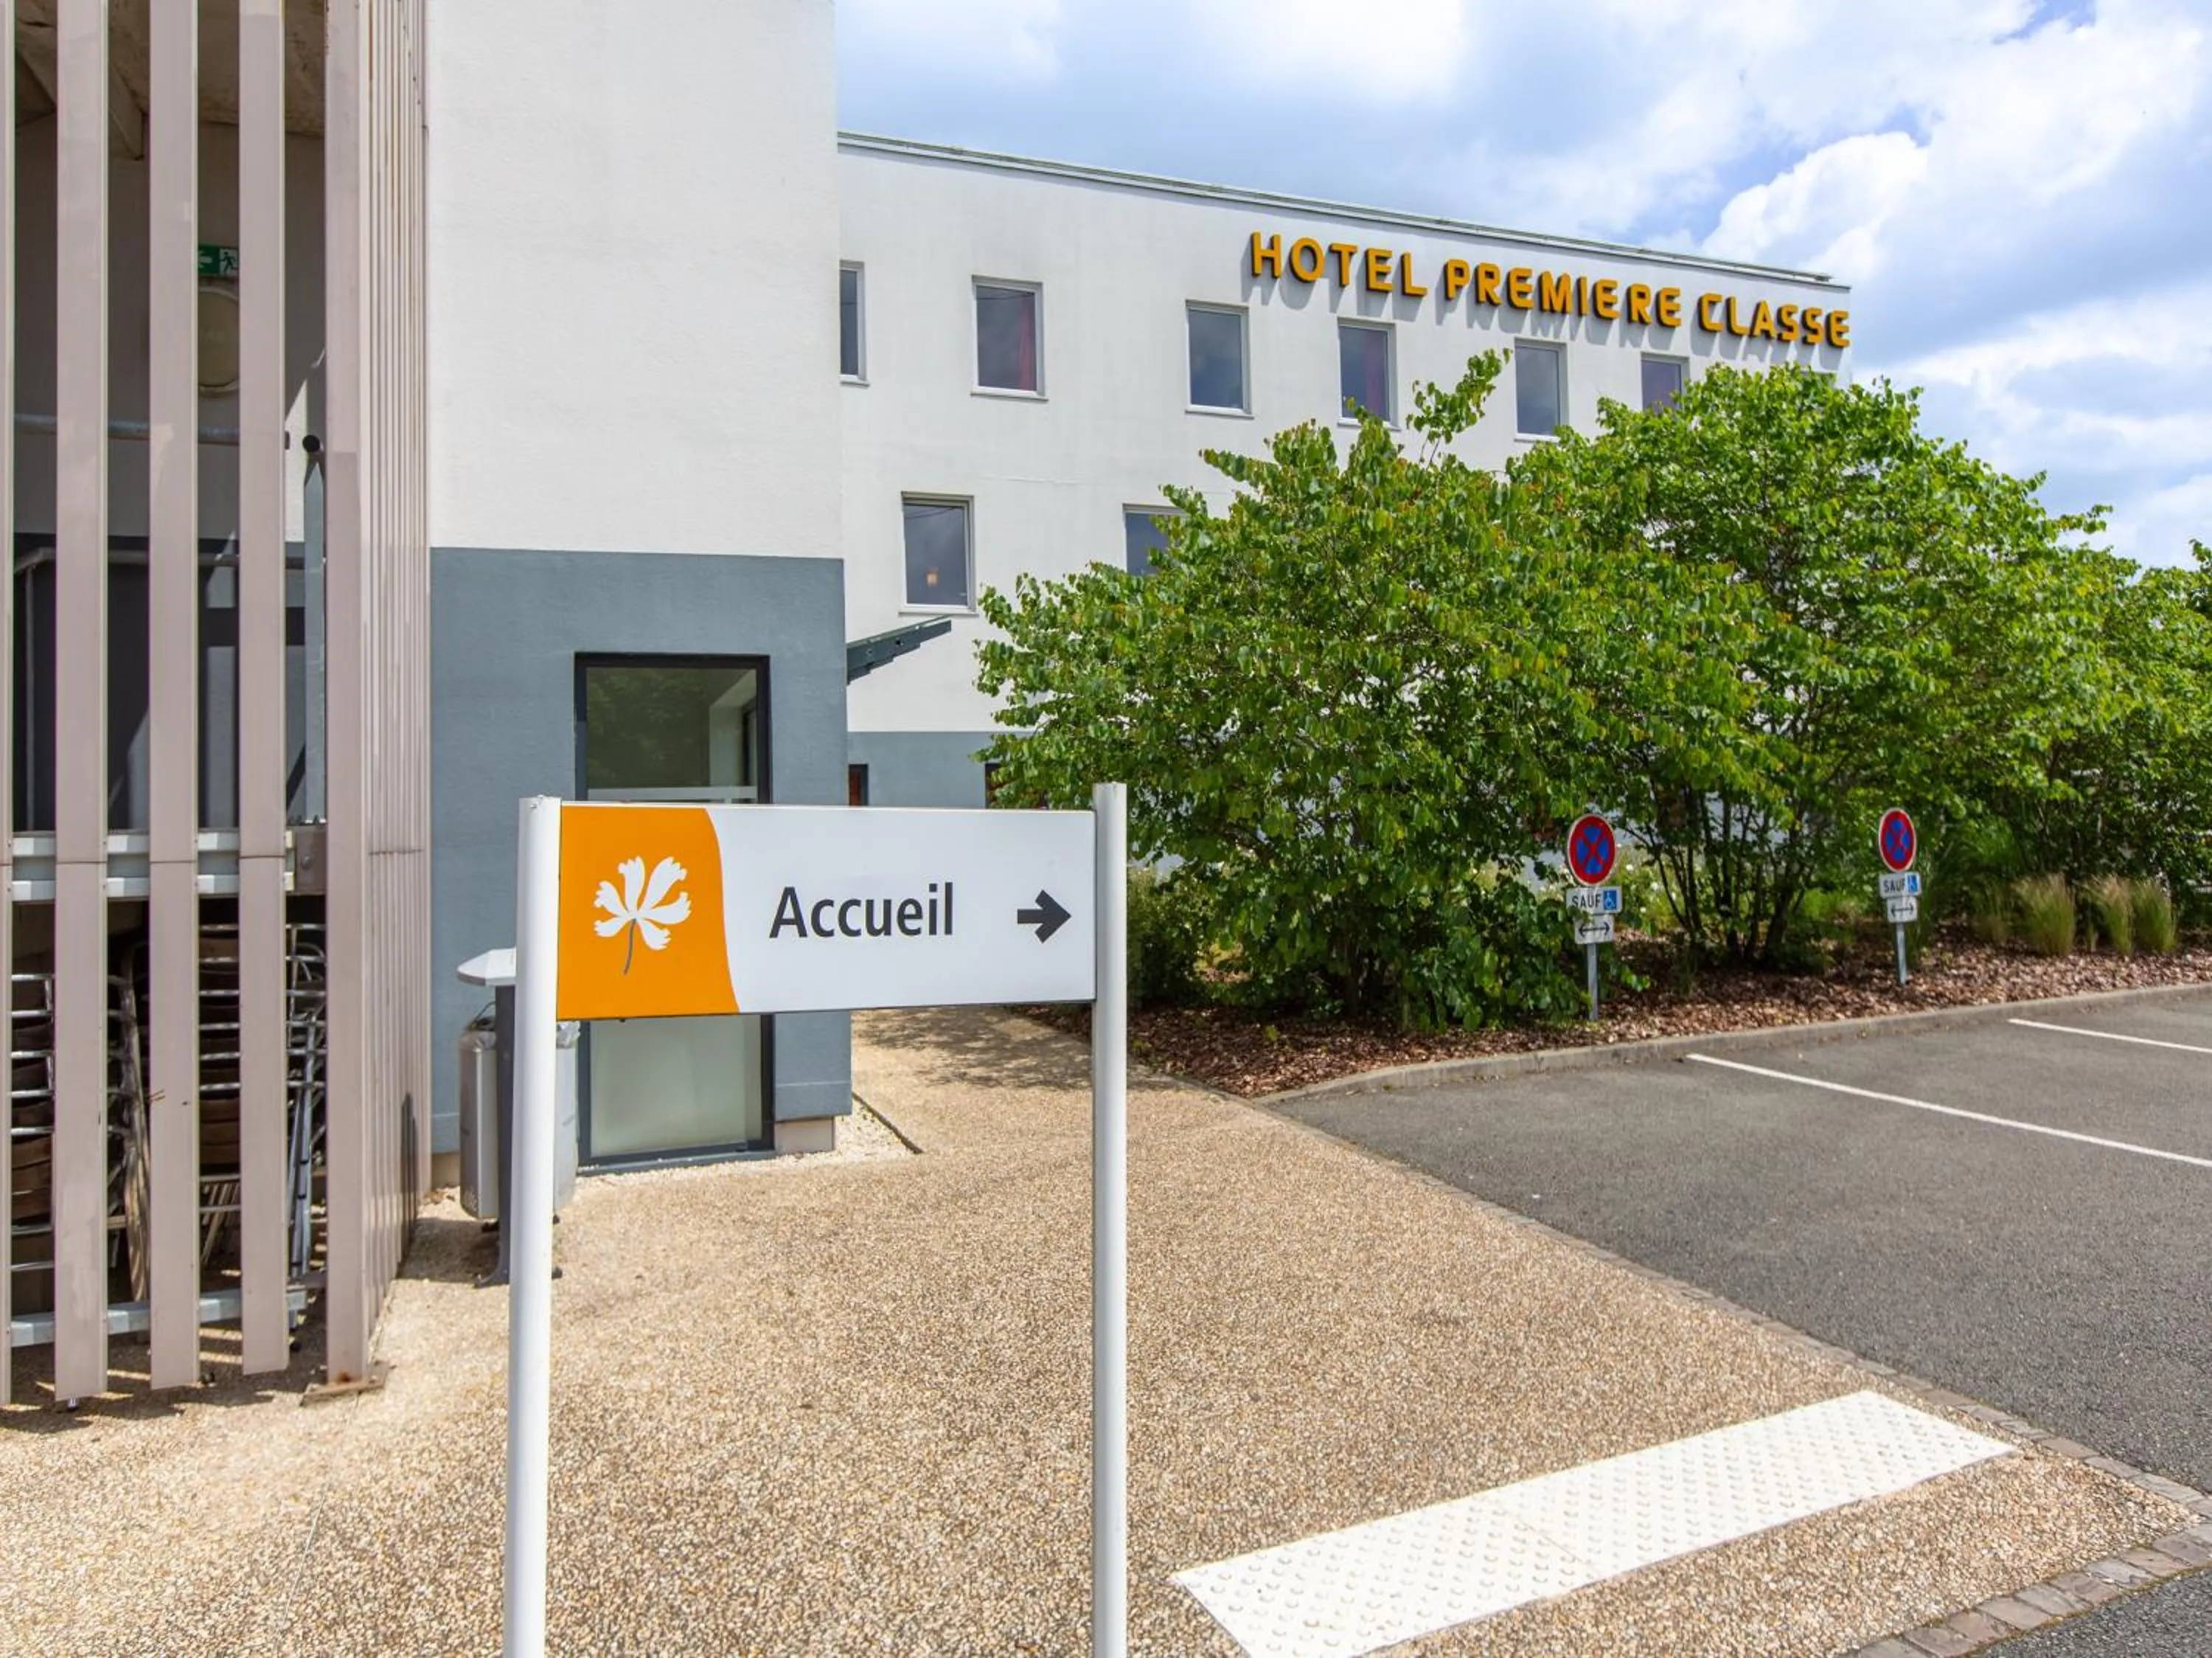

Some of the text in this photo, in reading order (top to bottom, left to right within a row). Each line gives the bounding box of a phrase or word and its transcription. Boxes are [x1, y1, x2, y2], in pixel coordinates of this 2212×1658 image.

[1251, 232, 1850, 347] HOTEL PREMIERE CLASSE
[1571, 893, 1601, 908] SAUF
[1883, 878, 1905, 892] SAUF
[769, 881, 953, 938] Accueil
